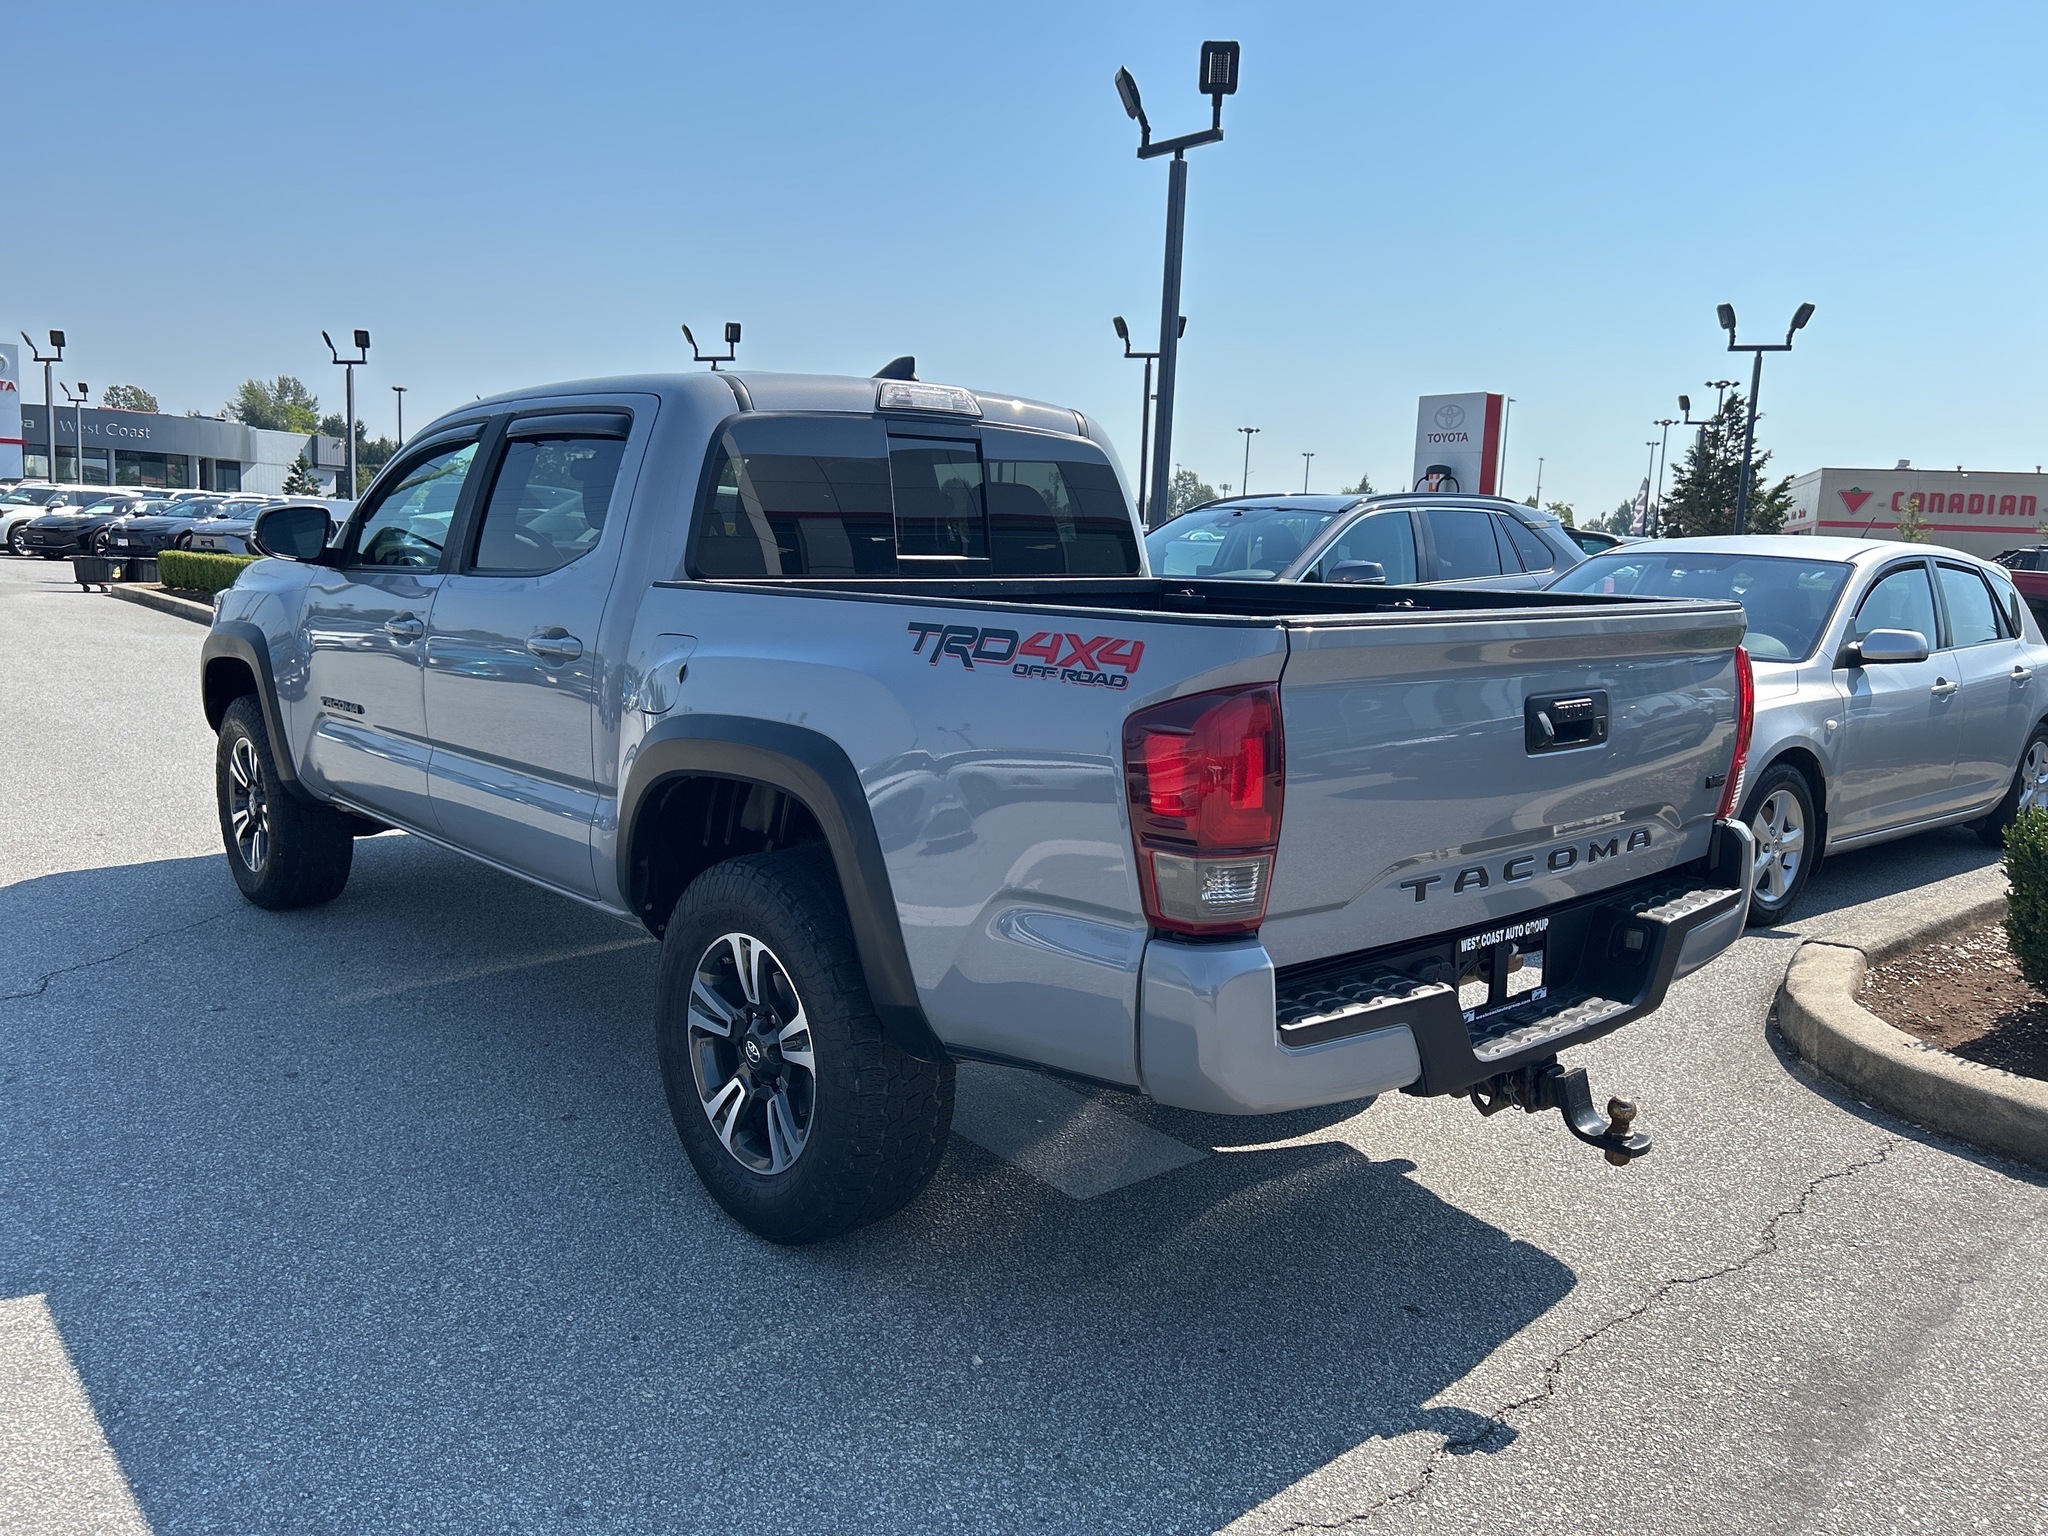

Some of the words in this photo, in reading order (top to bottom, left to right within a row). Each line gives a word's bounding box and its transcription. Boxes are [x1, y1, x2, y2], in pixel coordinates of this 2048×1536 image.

[60, 420, 99, 435] West
[105, 423, 151, 439] Coast
[1427, 432, 1469, 443] TOYOTA
[1891, 491, 2037, 516] CANADIAN
[907, 621, 1020, 673] TRD
[1012, 663, 1059, 681] OFF
[1060, 668, 1130, 691] ROAD
[321, 696, 360, 714] TACOMA
[1400, 827, 1653, 904] TACOMA
[1461, 936, 1480, 953] WEST
[1481, 929, 1504, 947] COAST
[1505, 924, 1524, 941] AUTO
[1525, 918, 1549, 935] GROUP
